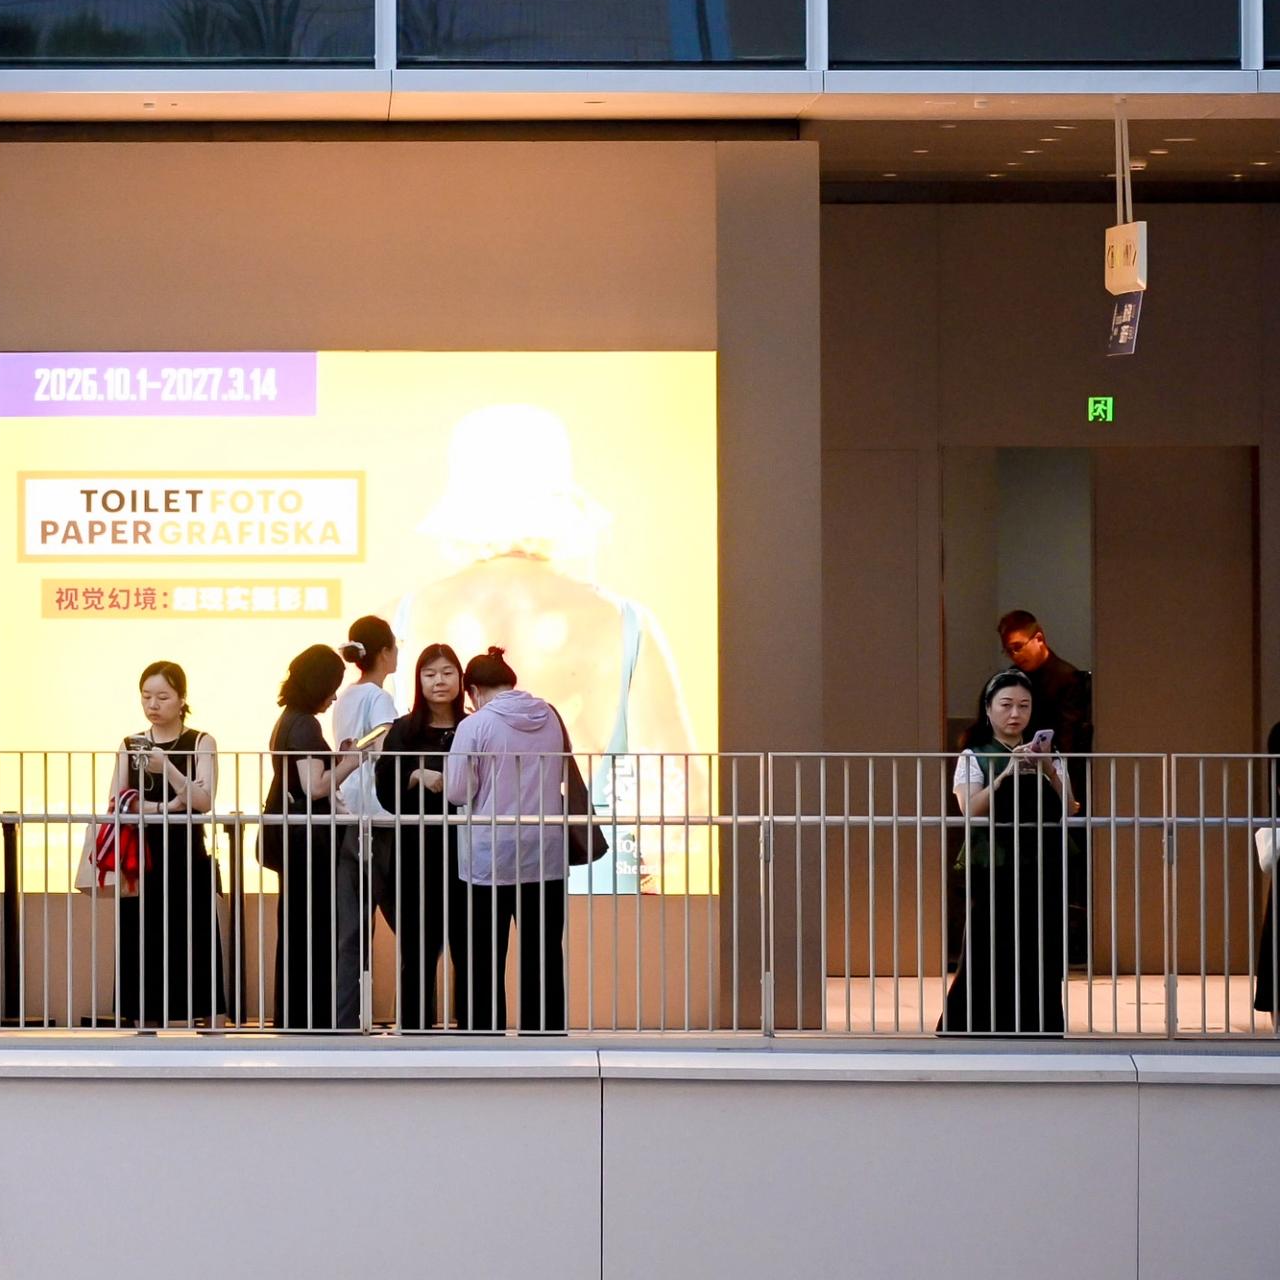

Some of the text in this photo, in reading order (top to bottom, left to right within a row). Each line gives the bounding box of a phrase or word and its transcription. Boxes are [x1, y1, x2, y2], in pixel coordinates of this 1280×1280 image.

[79, 489, 304, 515] TOILET FOTO
[40, 519, 342, 546] PAPER GRAFISKA
